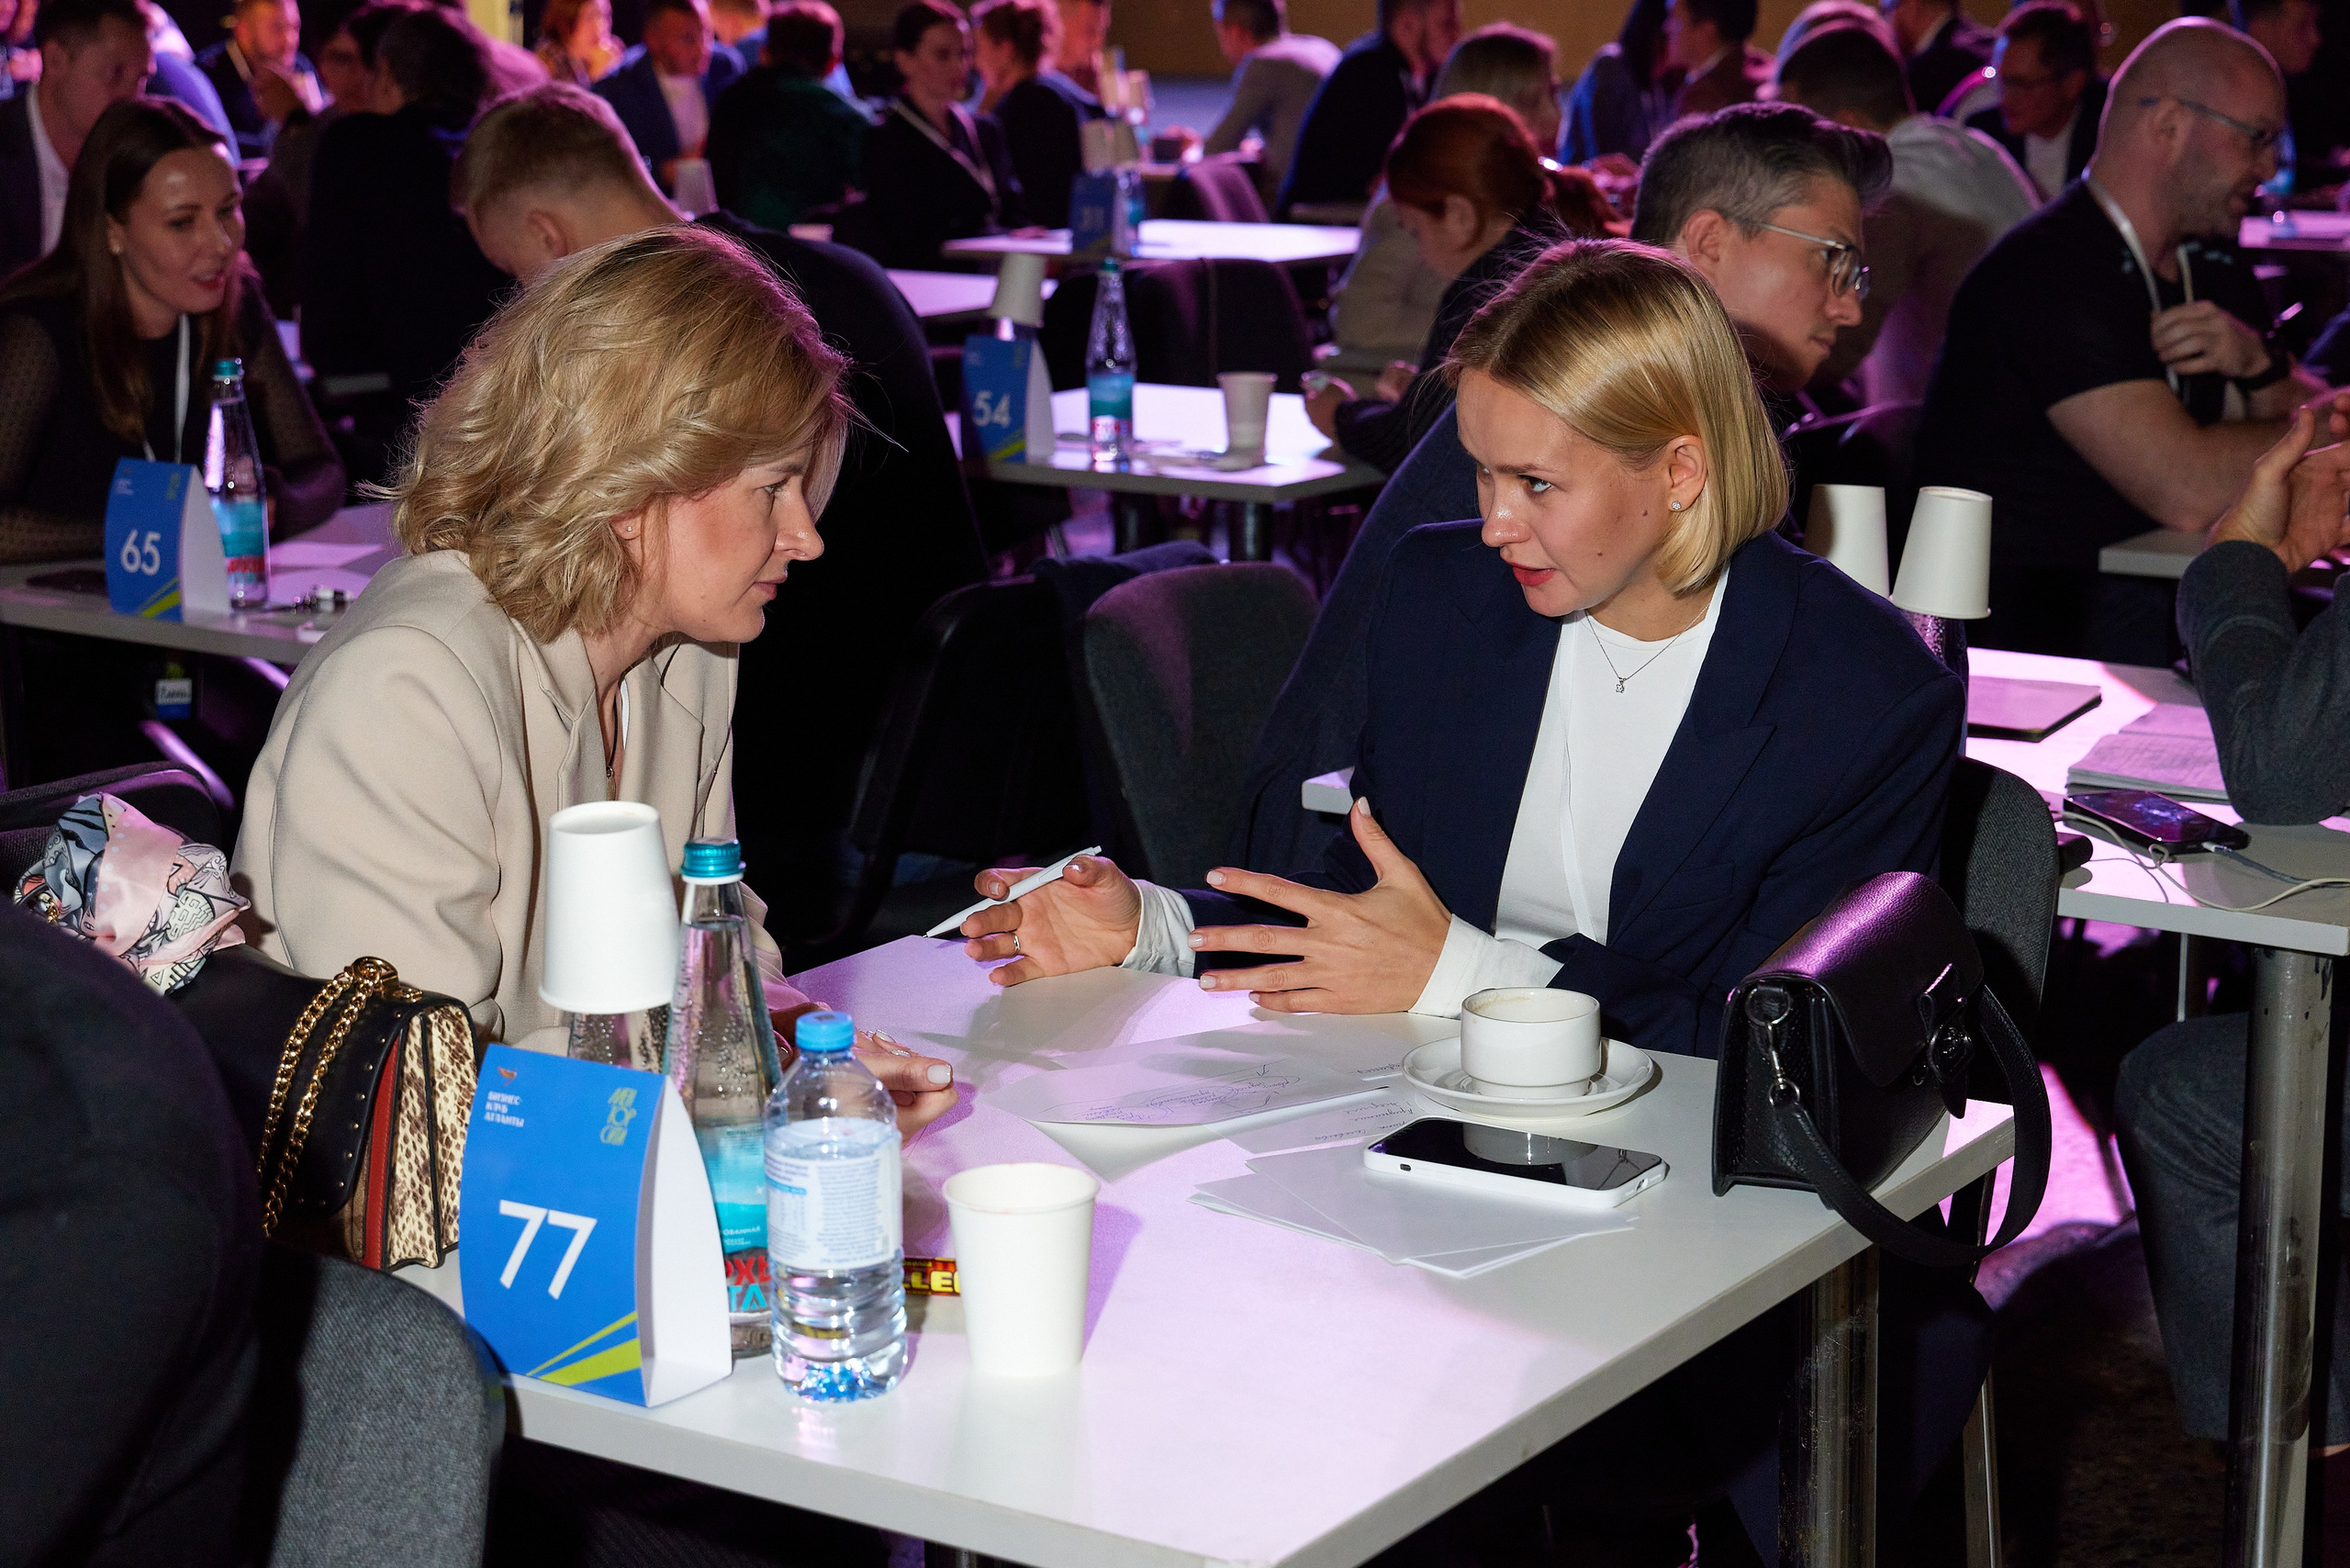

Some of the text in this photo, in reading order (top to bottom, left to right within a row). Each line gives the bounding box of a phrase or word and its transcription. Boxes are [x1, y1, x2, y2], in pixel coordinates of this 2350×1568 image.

[973, 391, 1011, 427] 54
[120, 529, 161, 576] 65
[498, 1200, 598, 1300] 77
